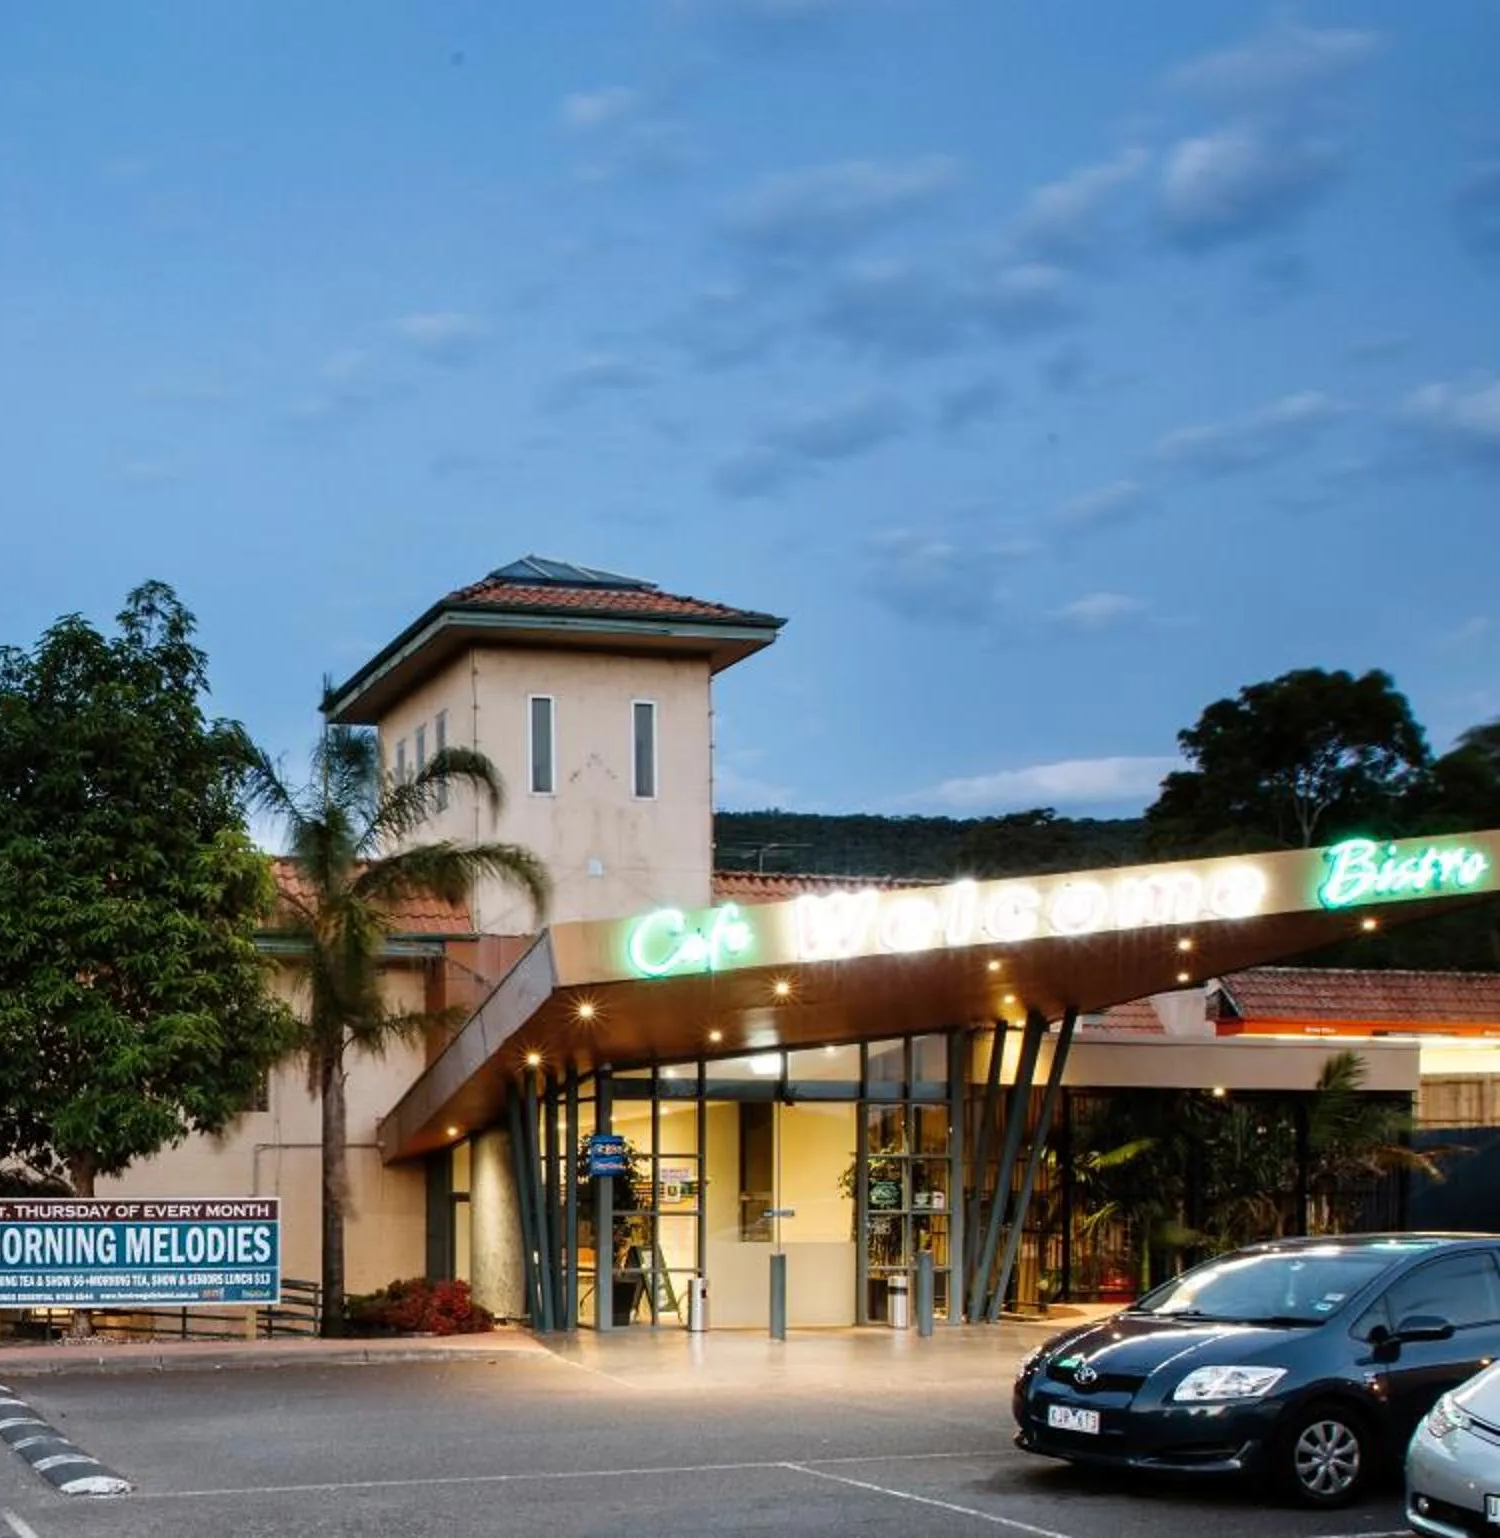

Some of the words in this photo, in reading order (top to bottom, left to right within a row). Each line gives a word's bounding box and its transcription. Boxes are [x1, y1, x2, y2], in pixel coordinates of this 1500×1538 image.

[626, 902, 755, 977] Cafe
[795, 864, 1269, 962] Welcome
[1318, 837, 1489, 909] Bistro
[16, 1205, 109, 1218] THURSDAY
[116, 1205, 139, 1218] OF
[143, 1204, 202, 1218] EVERY
[205, 1204, 270, 1218] MONTH
[124, 1226, 271, 1264] MELODIES
[20, 1275, 35, 1287] TEA
[45, 1275, 71, 1287] SHOW
[152, 1274, 177, 1286] SHOW
[188, 1273, 223, 1286] SENIORS
[225, 1273, 253, 1285] LUNCH
